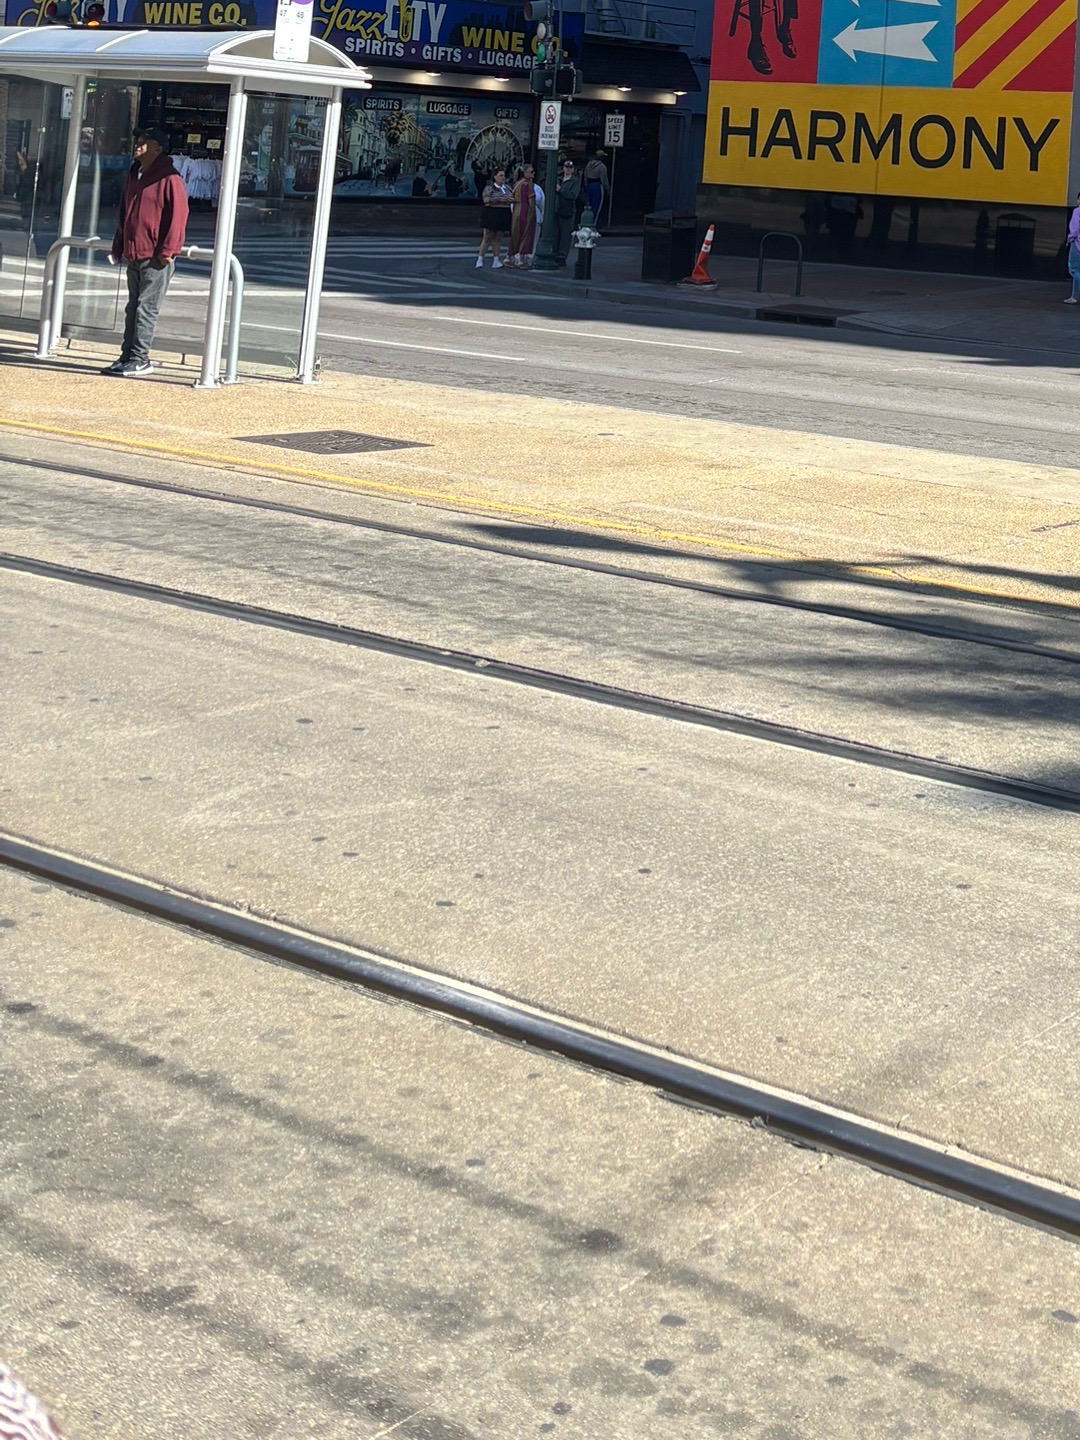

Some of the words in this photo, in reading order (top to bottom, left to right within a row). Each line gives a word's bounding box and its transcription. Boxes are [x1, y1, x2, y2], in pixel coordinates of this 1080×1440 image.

[144, 2, 202, 25] WINE
[208, 2, 248, 26] CO.
[462, 26, 525, 53] WINE
[344, 37, 405, 57] SPIRITS
[422, 44, 462, 63] GIFTS
[478, 50, 541, 69] LUGGAGE
[365, 98, 400, 110] SPIRITS
[428, 102, 470, 115] LUGGAGE
[495, 108, 519, 118] GIFTS
[608, 131, 620, 143] 15
[719, 106, 1061, 172] HARMONY
